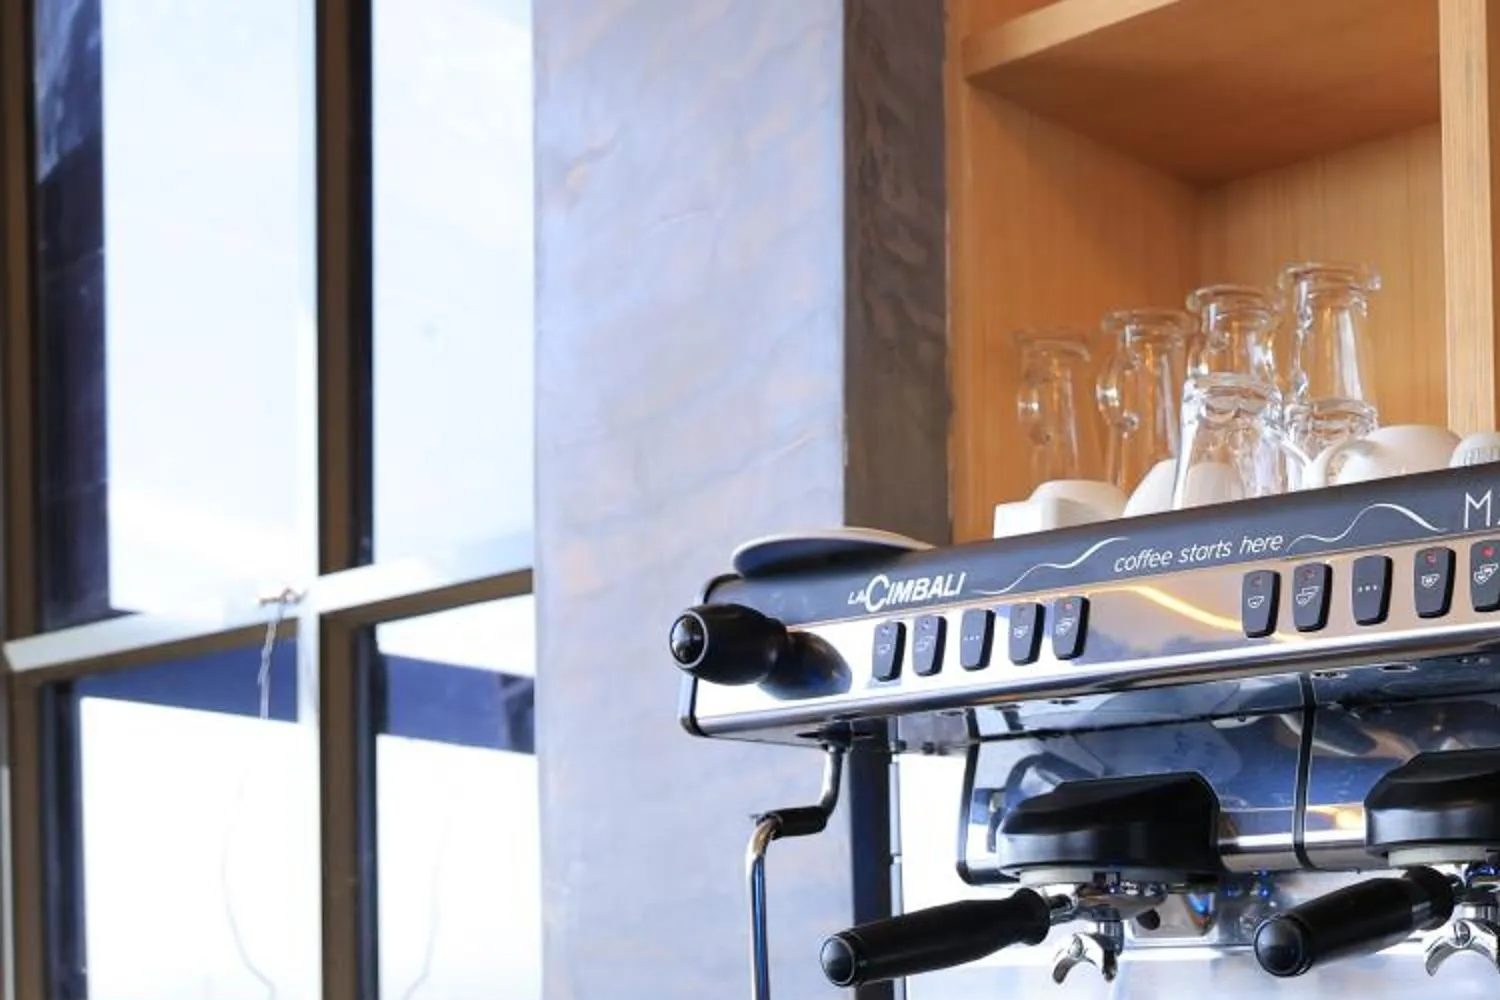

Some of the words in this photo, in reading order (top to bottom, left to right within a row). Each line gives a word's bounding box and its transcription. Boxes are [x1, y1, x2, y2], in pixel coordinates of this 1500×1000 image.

[1114, 549, 1173, 573] coffee
[1178, 540, 1233, 564] starts
[1239, 534, 1283, 555] here
